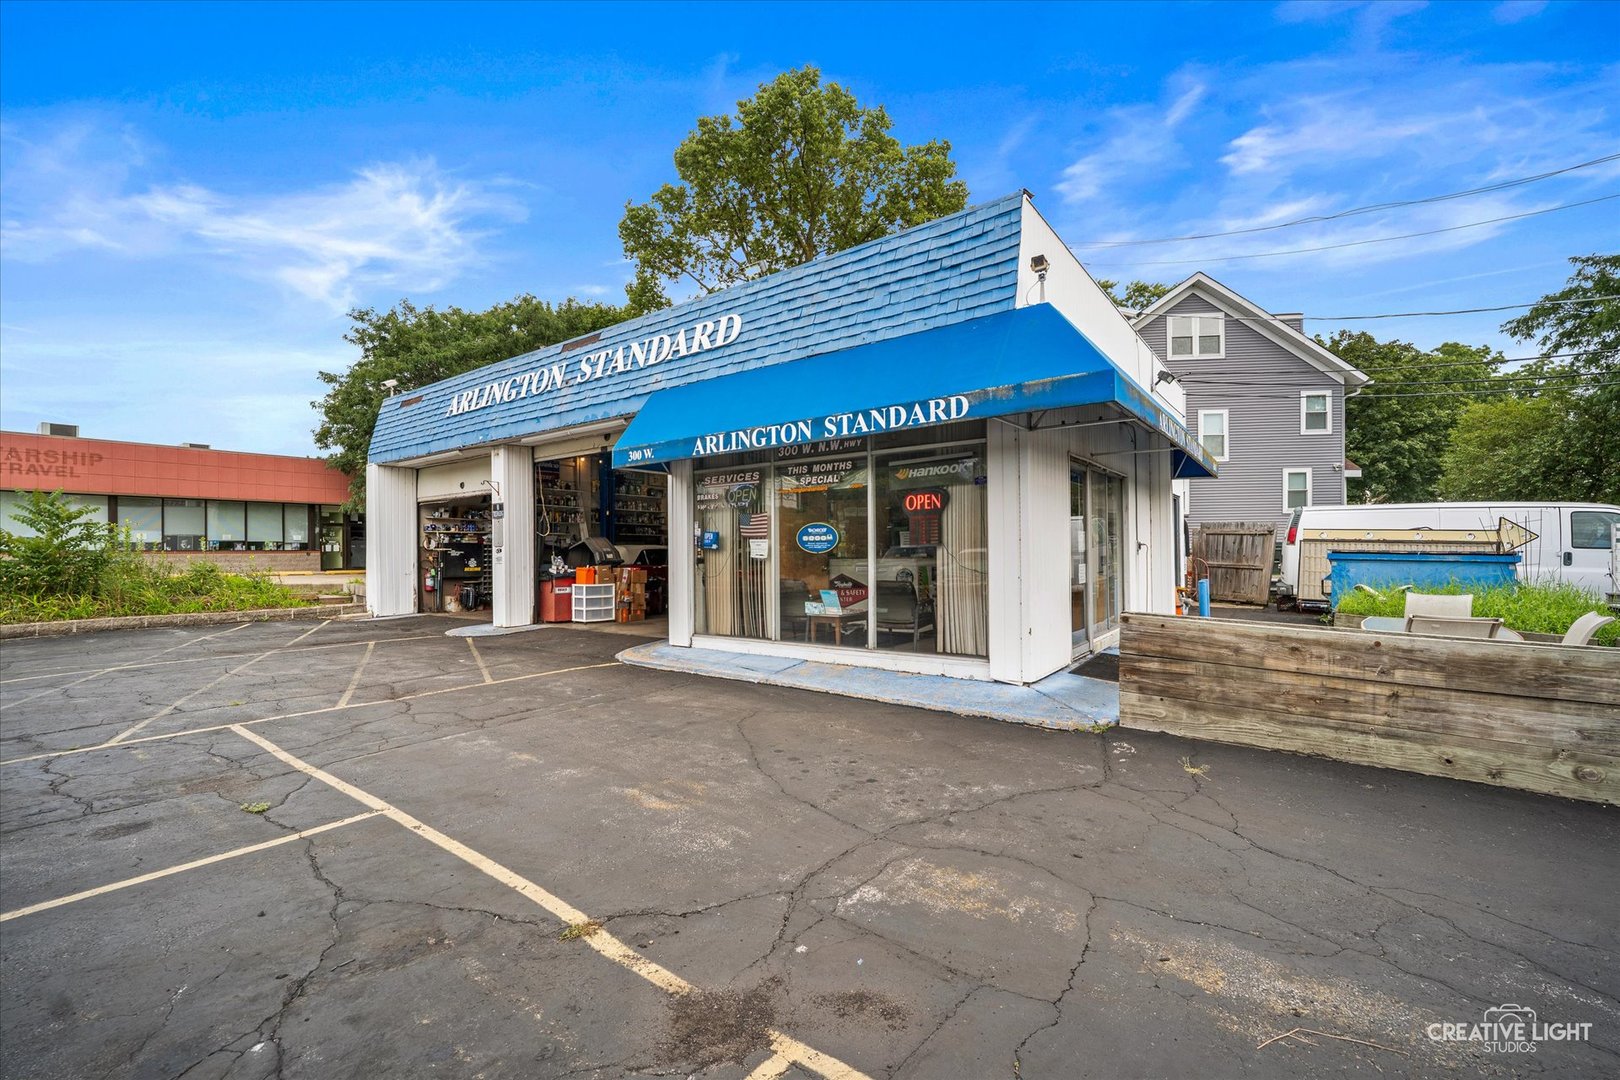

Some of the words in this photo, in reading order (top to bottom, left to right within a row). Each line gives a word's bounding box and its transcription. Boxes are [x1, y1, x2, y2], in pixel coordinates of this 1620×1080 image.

[446, 362, 568, 417] ARLINGTON
[577, 313, 743, 384] STANDARD
[628, 451, 642, 462] 300
[643, 448, 655, 459] W.
[692, 419, 812, 456] ARLINGTON
[824, 395, 970, 438] STANDARD
[0, 446, 104, 467] ARSHIP
[778, 446, 798, 457] 300
[802, 443, 815, 454] W.
[788, 465, 808, 475] THIS
[812, 460, 853, 473] MONTHS
[704, 471, 760, 485] SERVICES
[800, 474, 839, 485] SPECIAL
[727, 487, 758, 502] OPEN
[905, 493, 941, 511] OPEN
